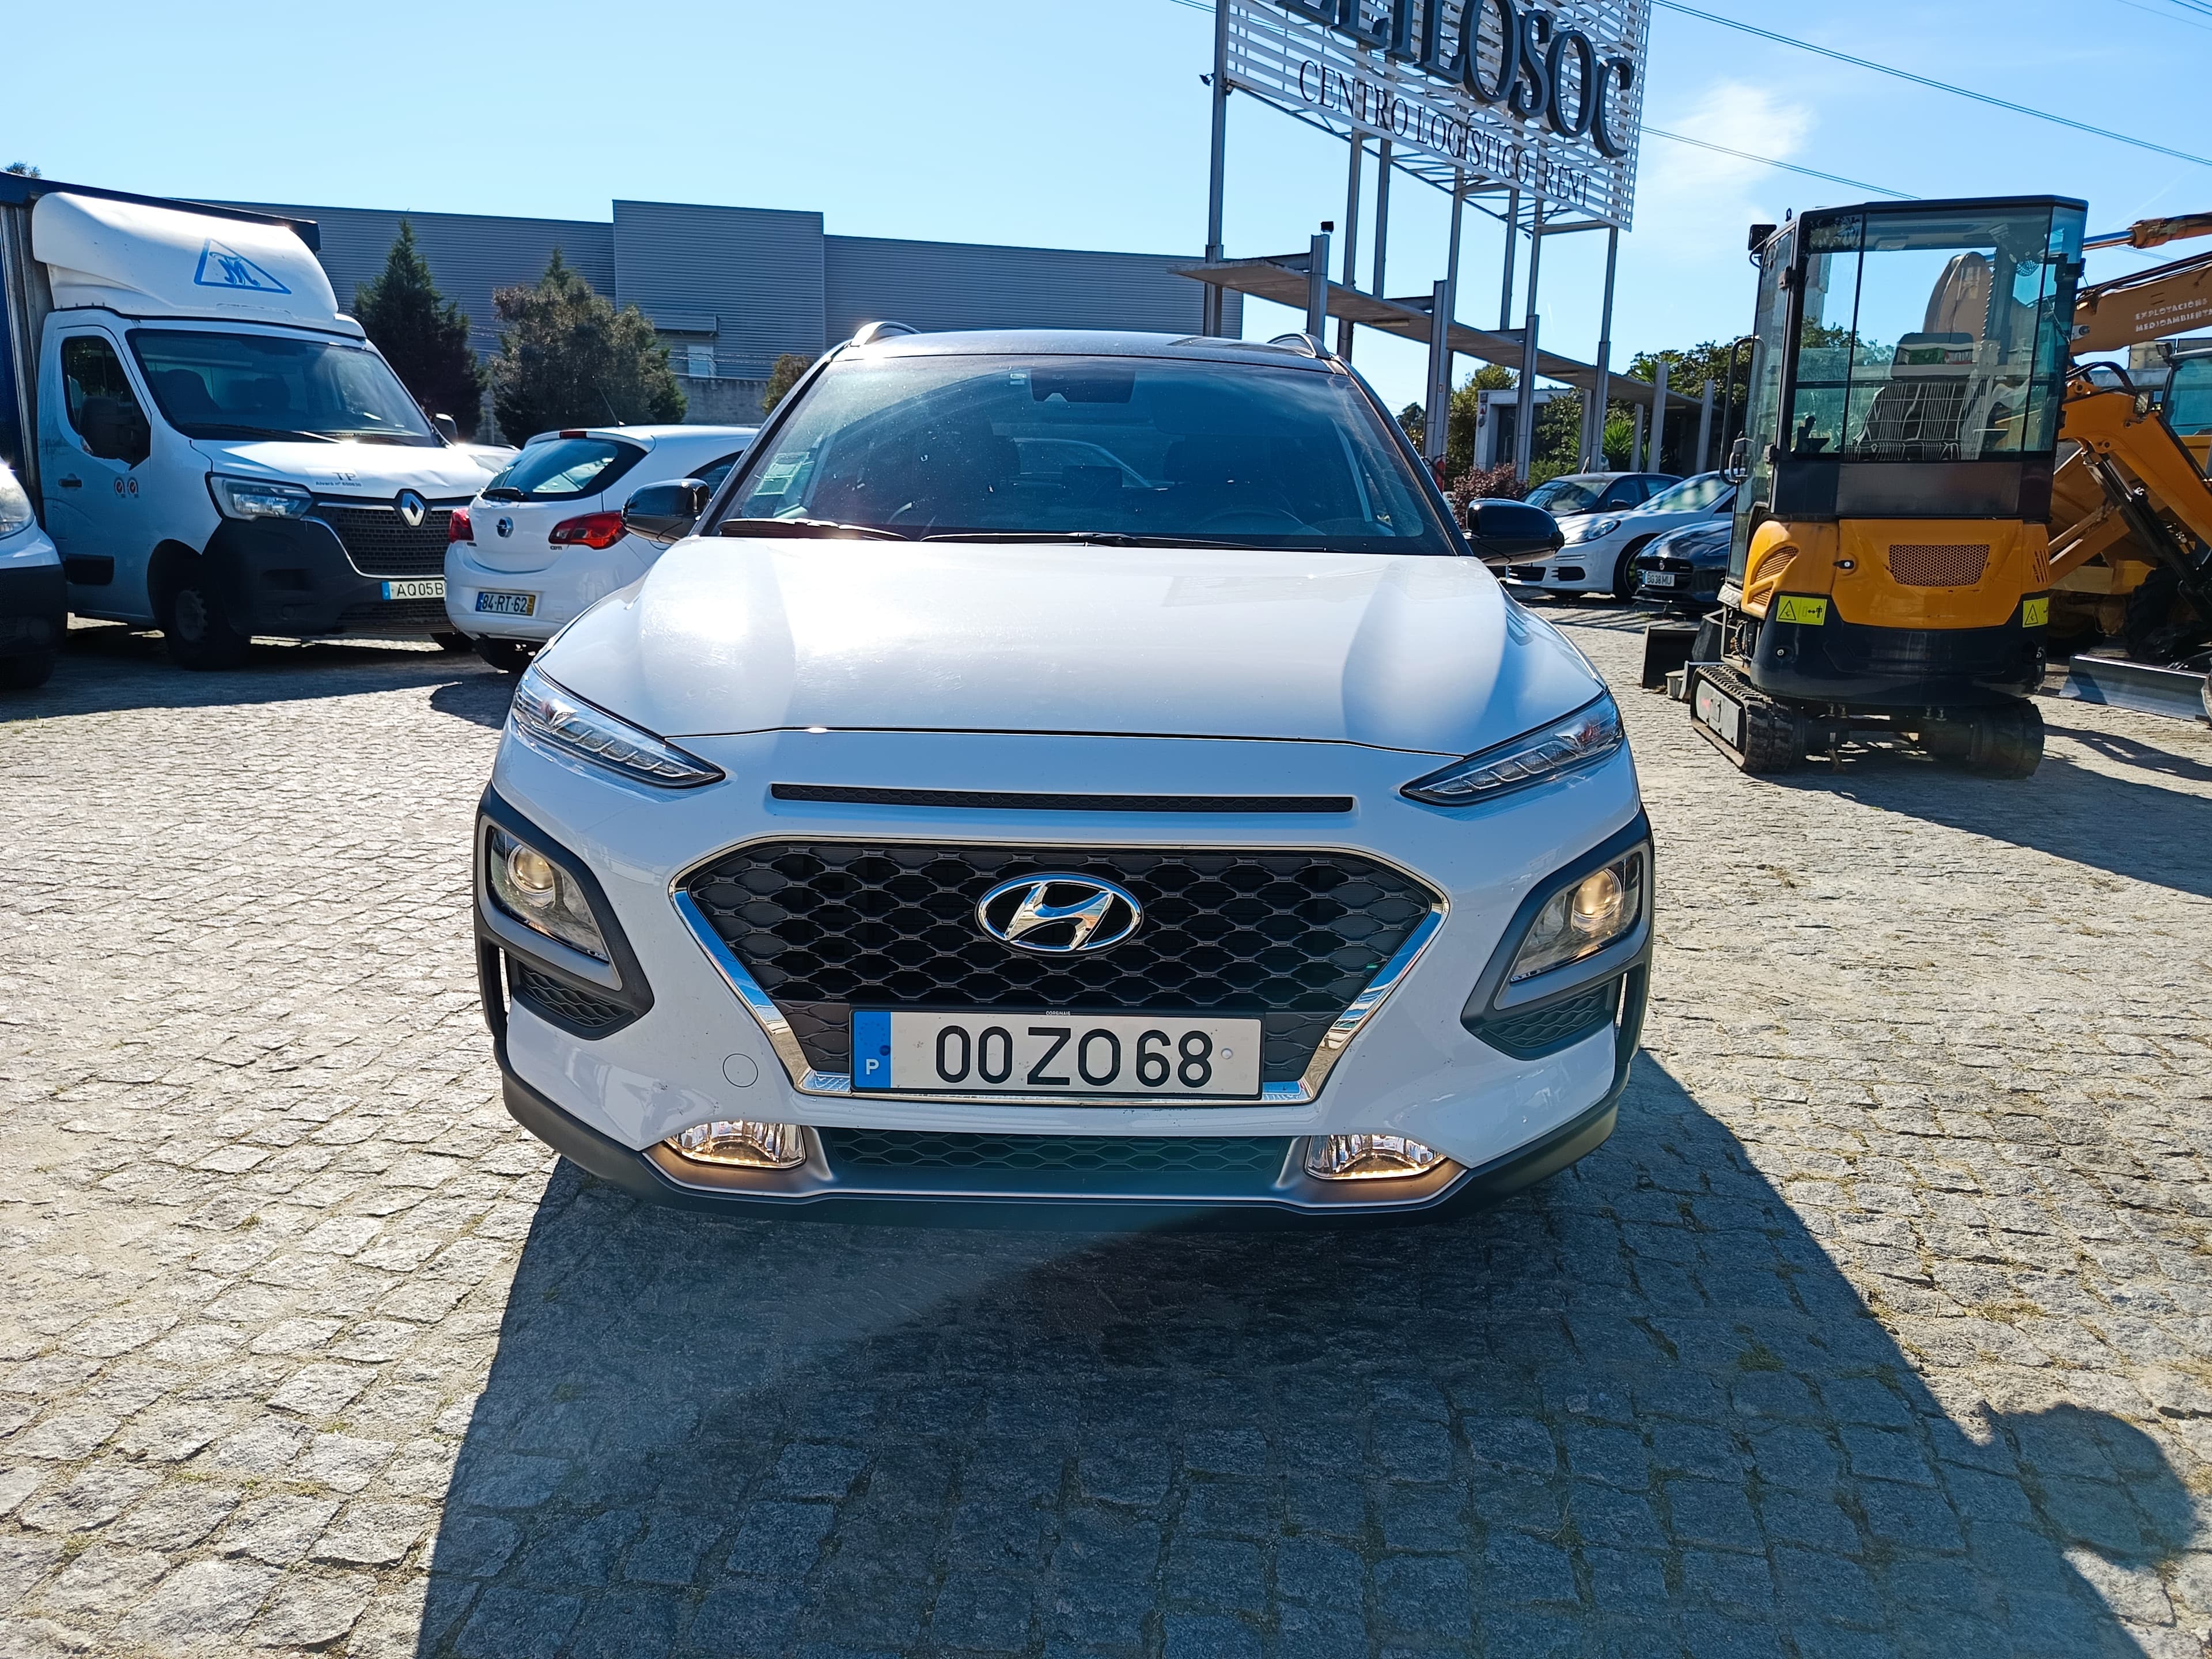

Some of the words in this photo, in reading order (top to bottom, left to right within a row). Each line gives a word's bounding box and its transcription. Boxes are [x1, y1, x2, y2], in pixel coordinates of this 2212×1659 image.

[1264, 0, 1634, 158] ILOSOC
[1300, 60, 1408, 137] CENTRO
[1544, 157, 1591, 207] RENT
[332, 472, 356, 481] TP
[866, 1059, 879, 1075] P
